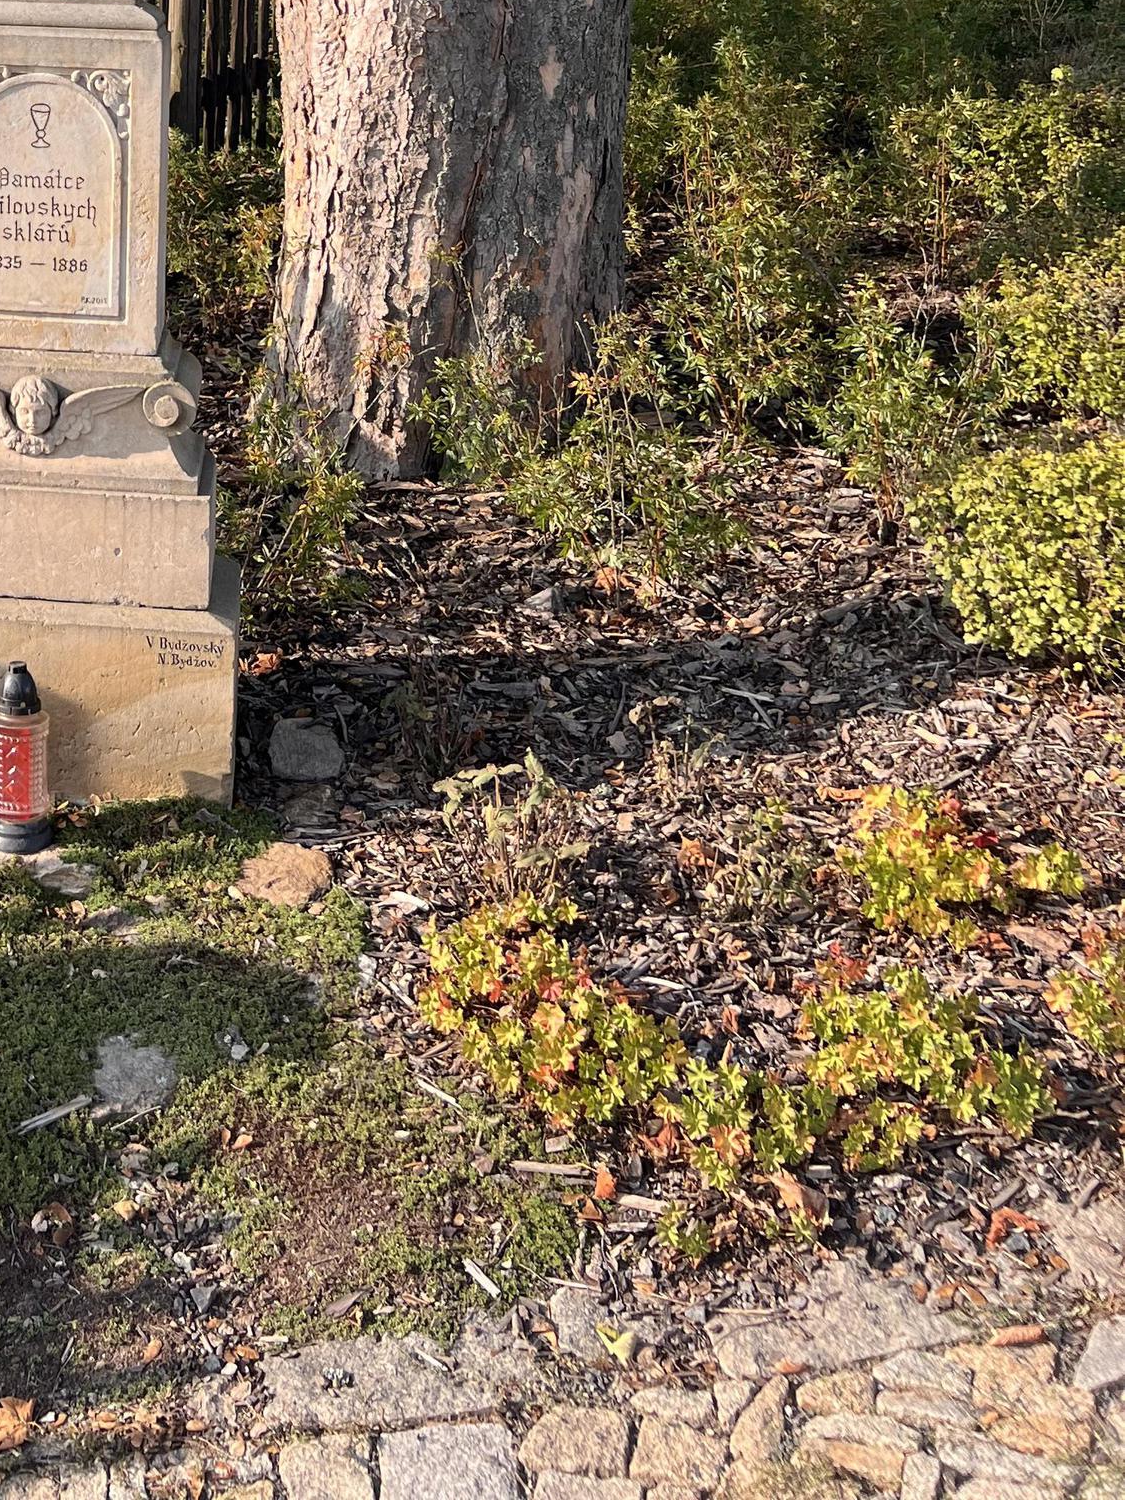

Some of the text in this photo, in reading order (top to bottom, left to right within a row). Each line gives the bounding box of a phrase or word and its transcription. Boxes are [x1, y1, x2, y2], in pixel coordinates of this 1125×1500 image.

[2, 220, 70, 243] sklářů
[52, 256, 88, 273] 1886
[159, 636, 225, 659] Bydžovský
